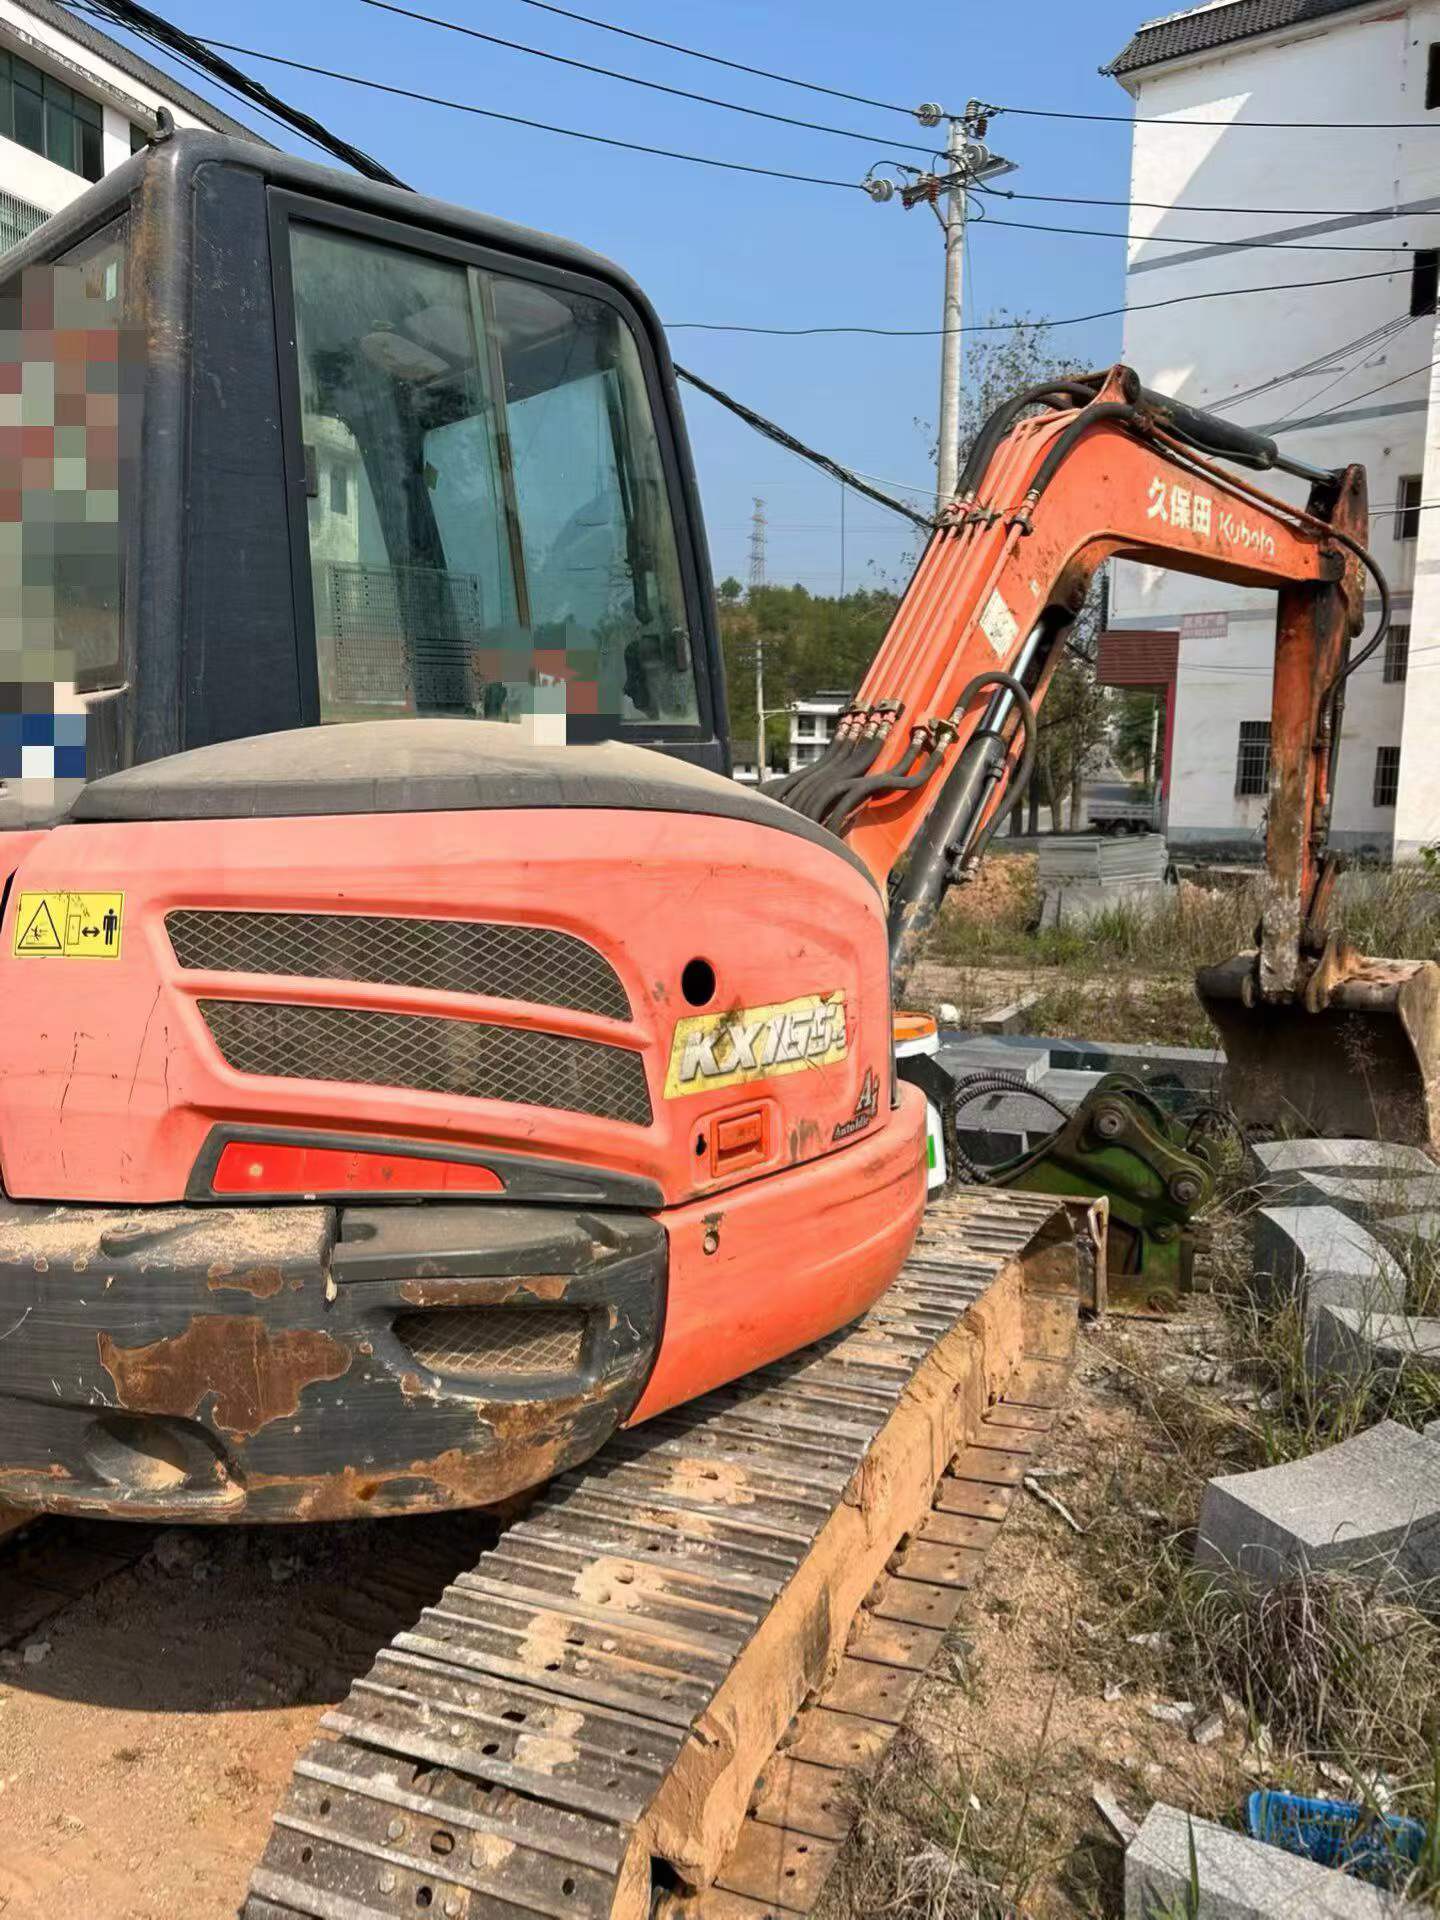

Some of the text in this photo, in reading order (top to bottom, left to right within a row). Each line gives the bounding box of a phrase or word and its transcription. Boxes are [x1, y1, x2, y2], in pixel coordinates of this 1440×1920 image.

[1146, 476, 1275, 556] 久保田 Kubota
